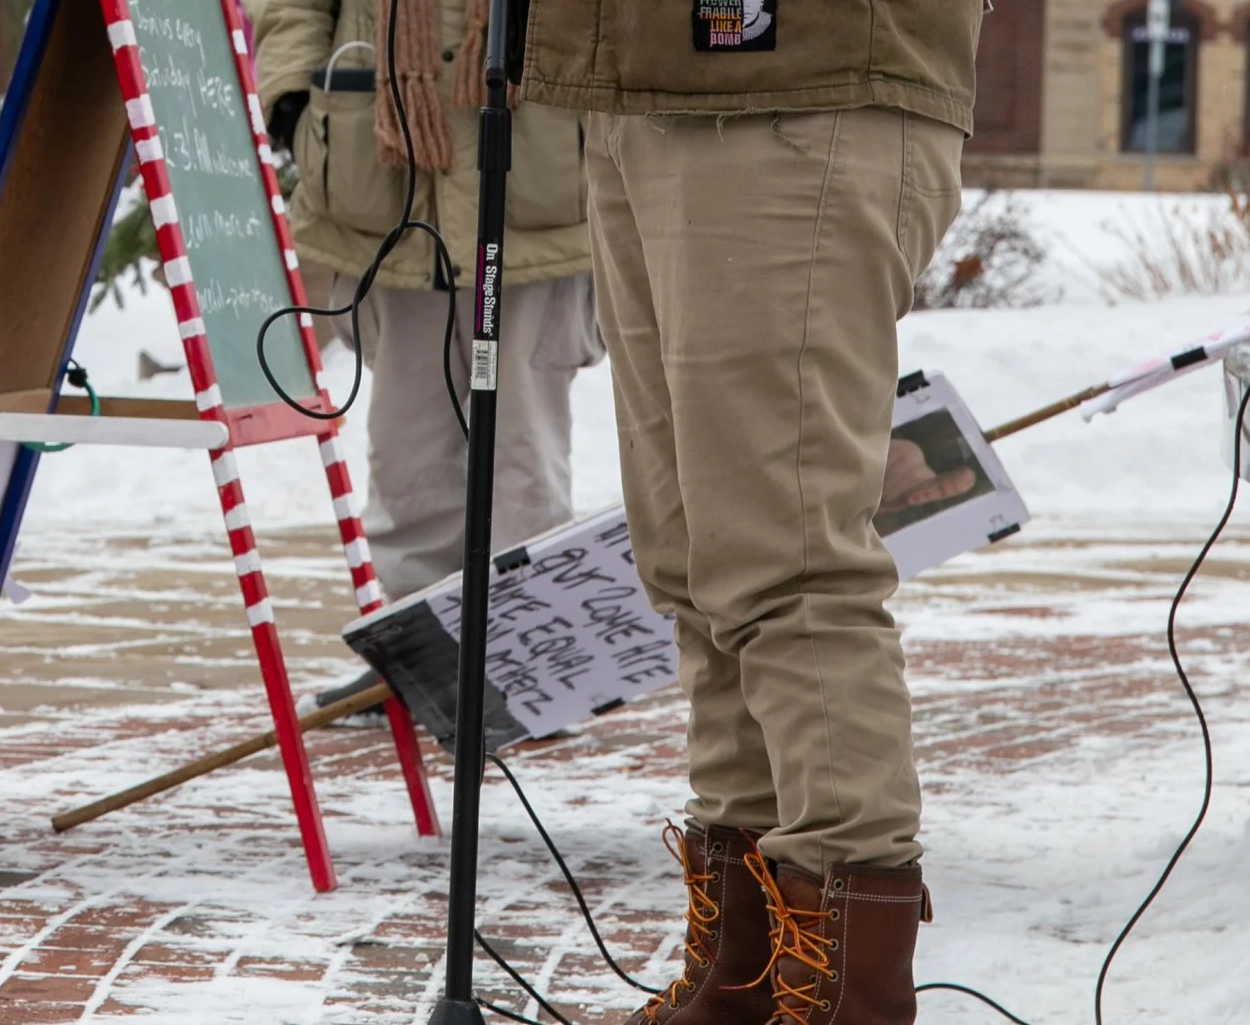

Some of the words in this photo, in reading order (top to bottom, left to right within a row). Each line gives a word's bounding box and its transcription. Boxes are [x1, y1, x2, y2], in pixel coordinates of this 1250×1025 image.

[699, 6, 742, 19] FRAGILE
[710, 20, 733, 33] LIKE
[734, 20, 742, 33] A
[710, 33, 742, 47] BOMB
[197, 67, 236, 117] HERE
[485, 242, 499, 261] On
[518, 616, 595, 691] EQUAL
